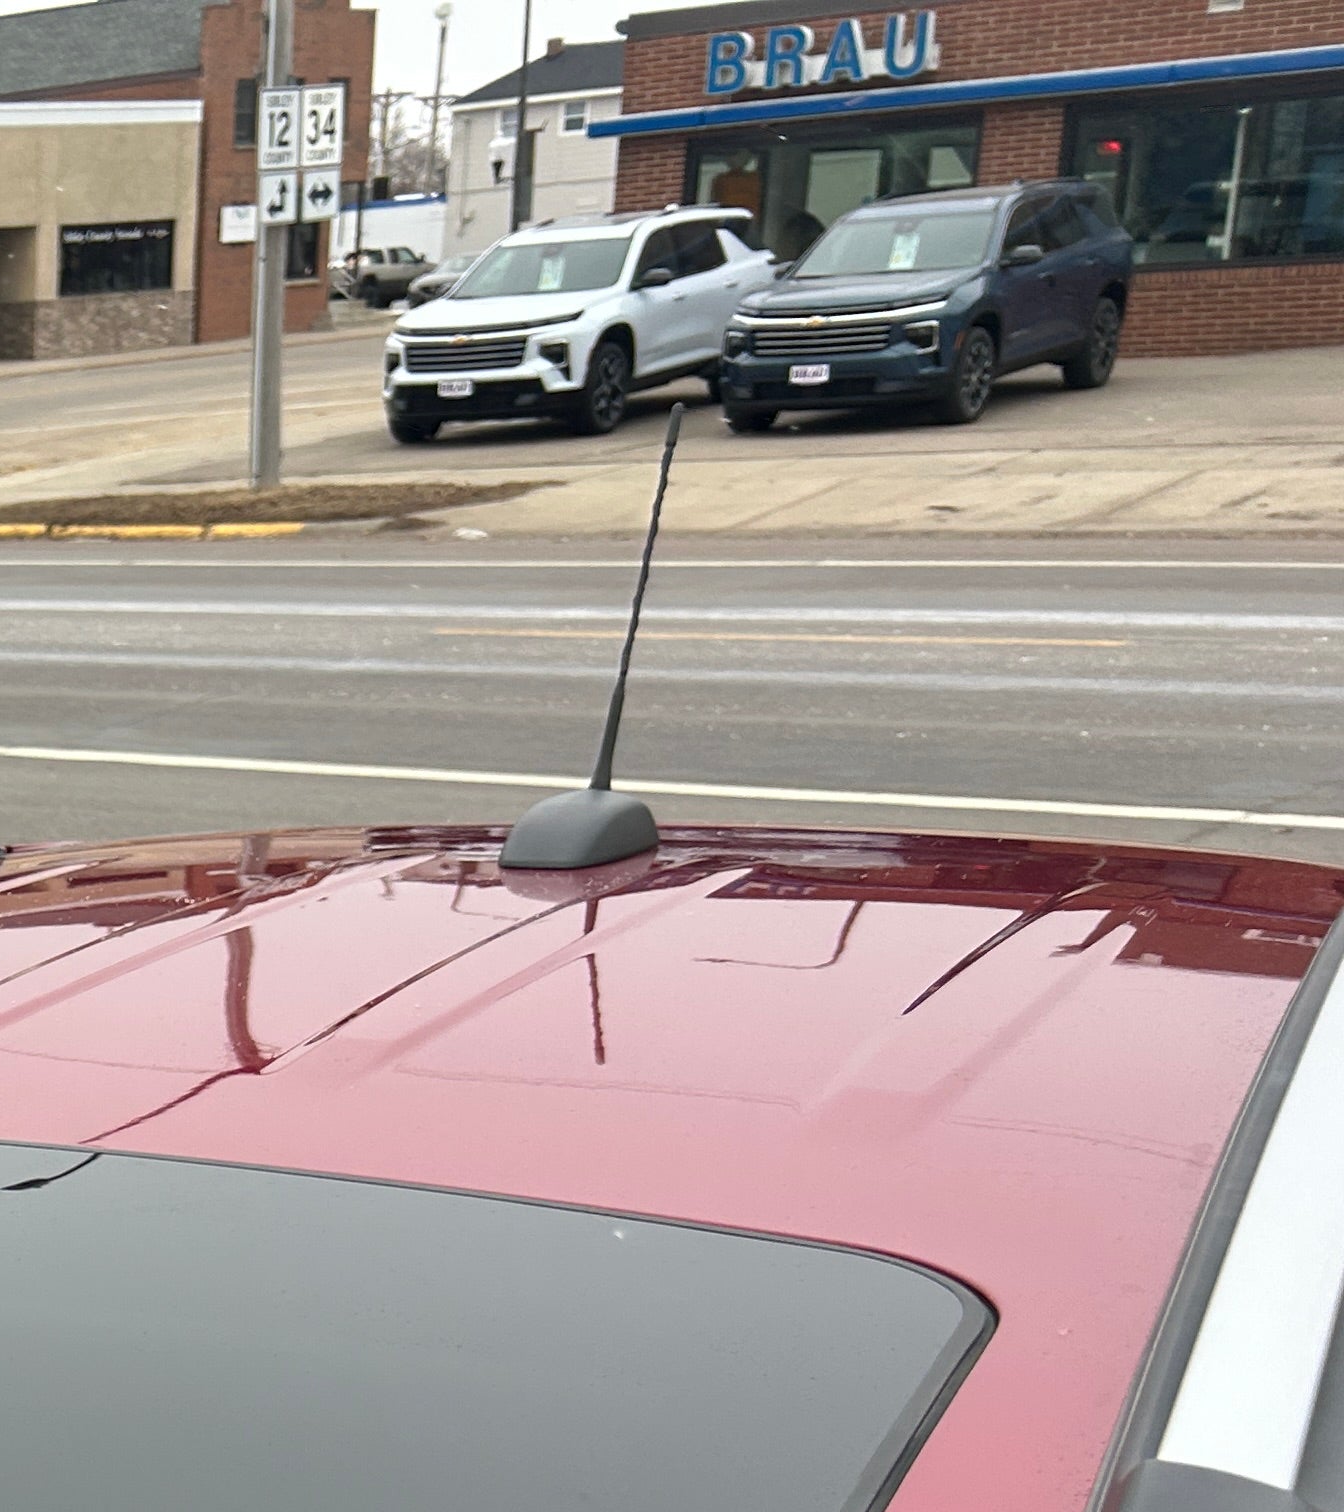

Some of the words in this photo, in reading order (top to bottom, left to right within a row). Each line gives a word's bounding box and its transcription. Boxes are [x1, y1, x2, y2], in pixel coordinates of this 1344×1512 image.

[705, 10, 932, 95] BRAU
[268, 111, 291, 148] 12
[307, 108, 337, 145] 34
